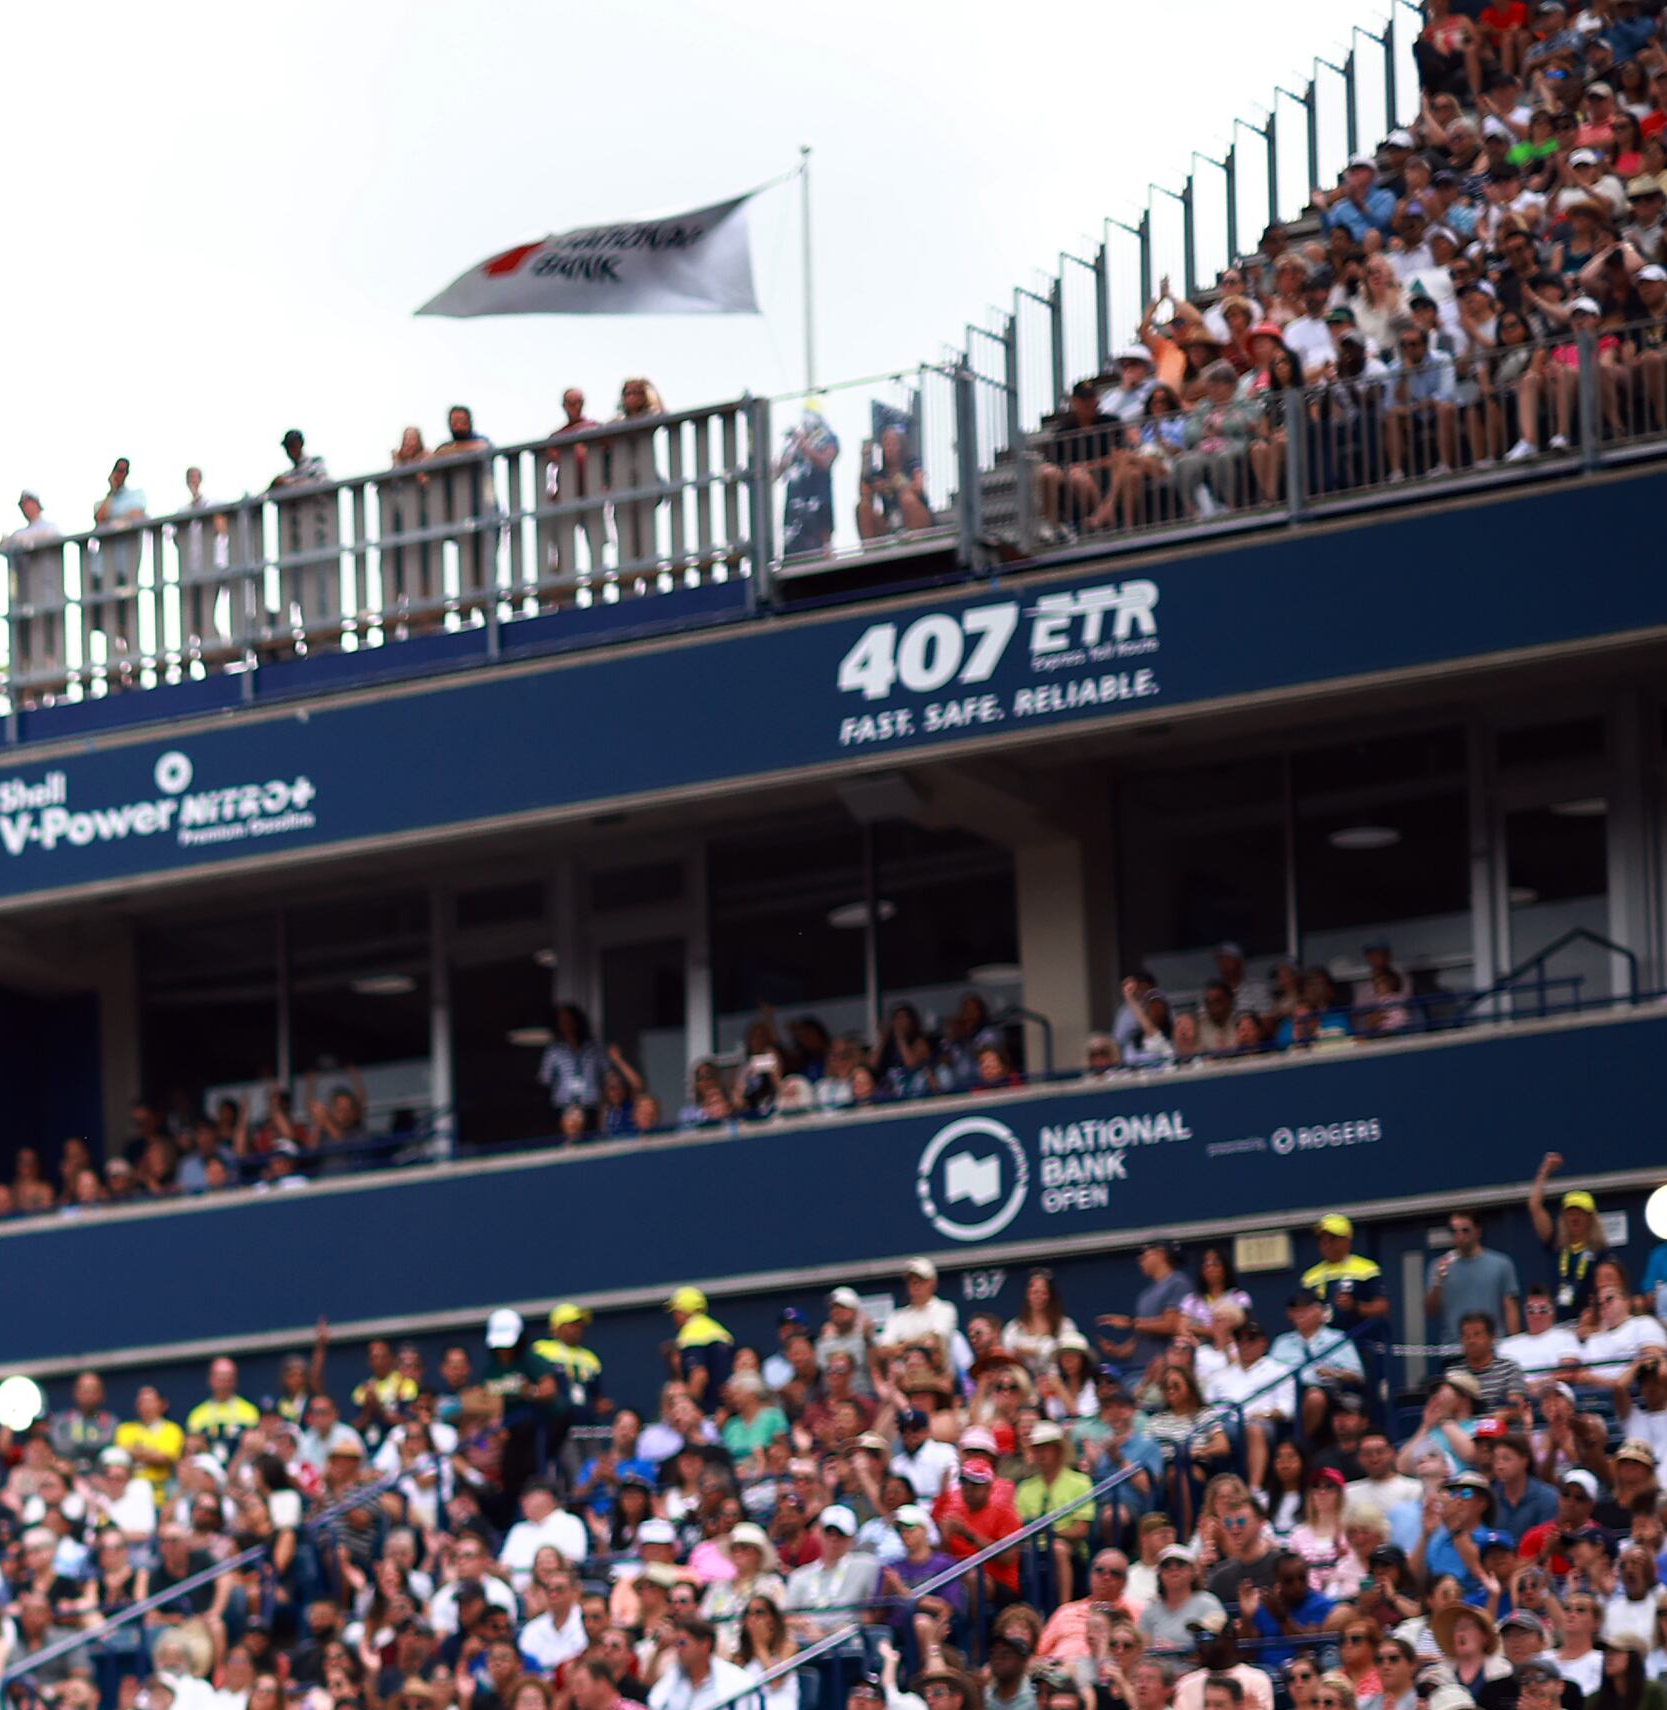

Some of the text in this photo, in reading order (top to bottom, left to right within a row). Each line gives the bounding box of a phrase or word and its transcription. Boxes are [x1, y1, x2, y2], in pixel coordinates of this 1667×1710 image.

[837, 579, 1160, 700] 407 ETR
[839, 668, 1160, 747] FAST. SAFE. RELIABLE.
[1039, 1109, 1194, 1157] NATIONAL
[1297, 1118, 1382, 1151] ROGERS
[1041, 1150, 1128, 1189] BANK
[1041, 1185, 1109, 1214] OPEN
